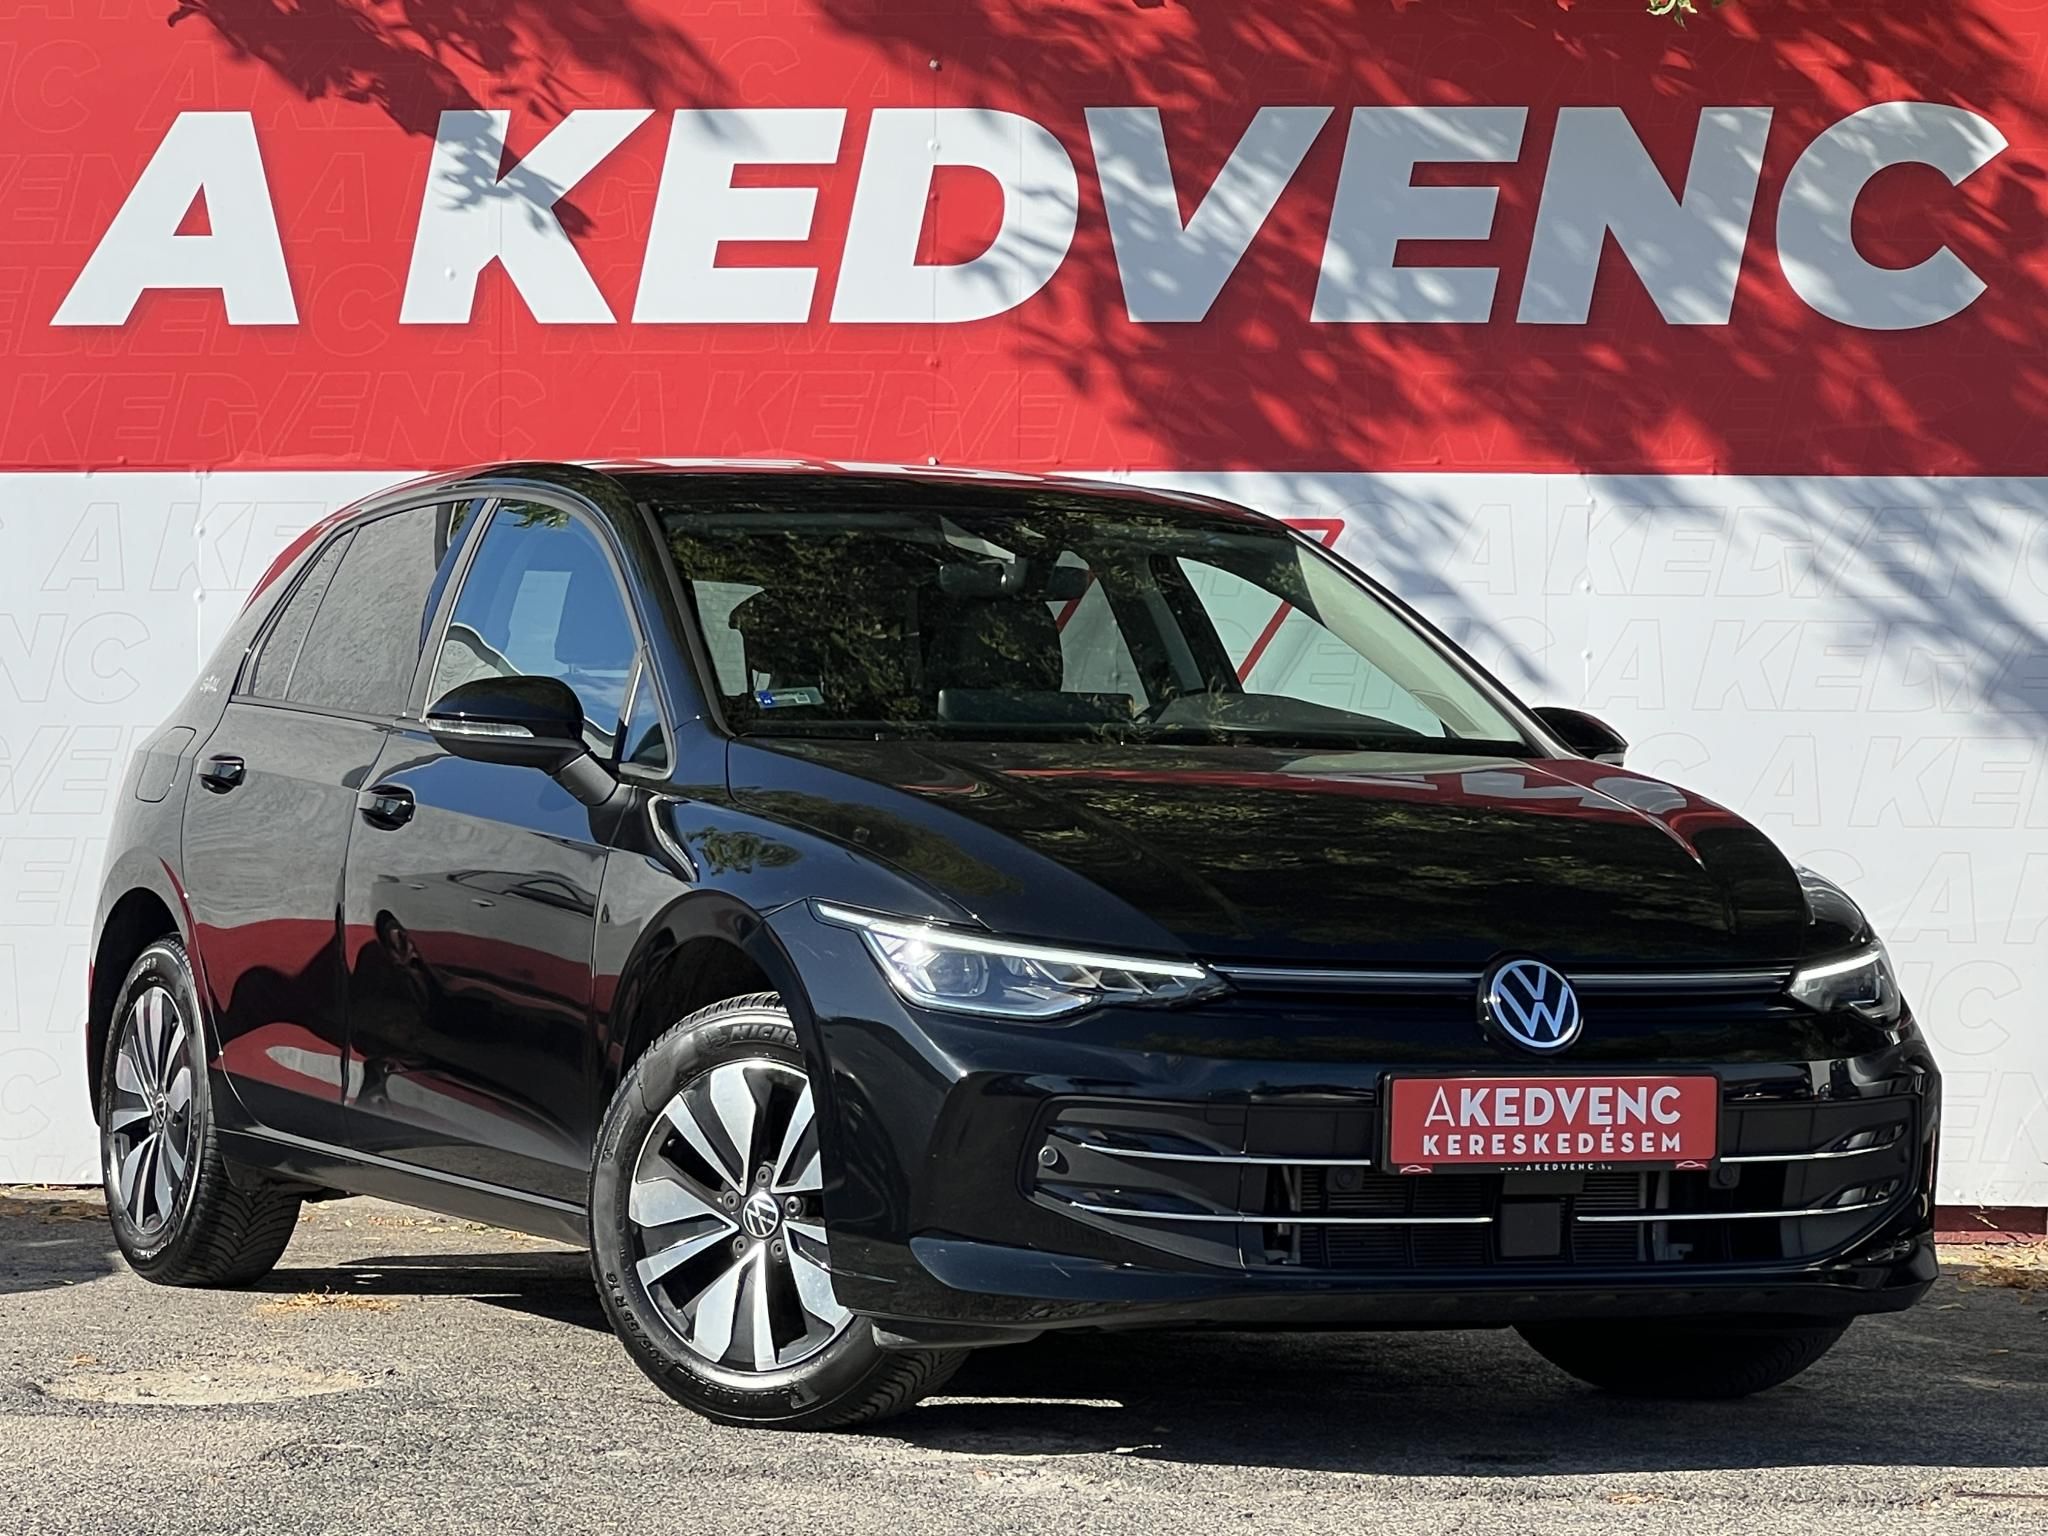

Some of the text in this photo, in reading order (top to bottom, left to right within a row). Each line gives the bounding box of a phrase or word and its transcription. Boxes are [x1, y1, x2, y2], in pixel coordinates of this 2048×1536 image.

[49, 109, 300, 327] A
[399, 100, 2010, 330] KEDVENC
[1423, 1127, 1681, 1155] KERESKEDÉSEM
